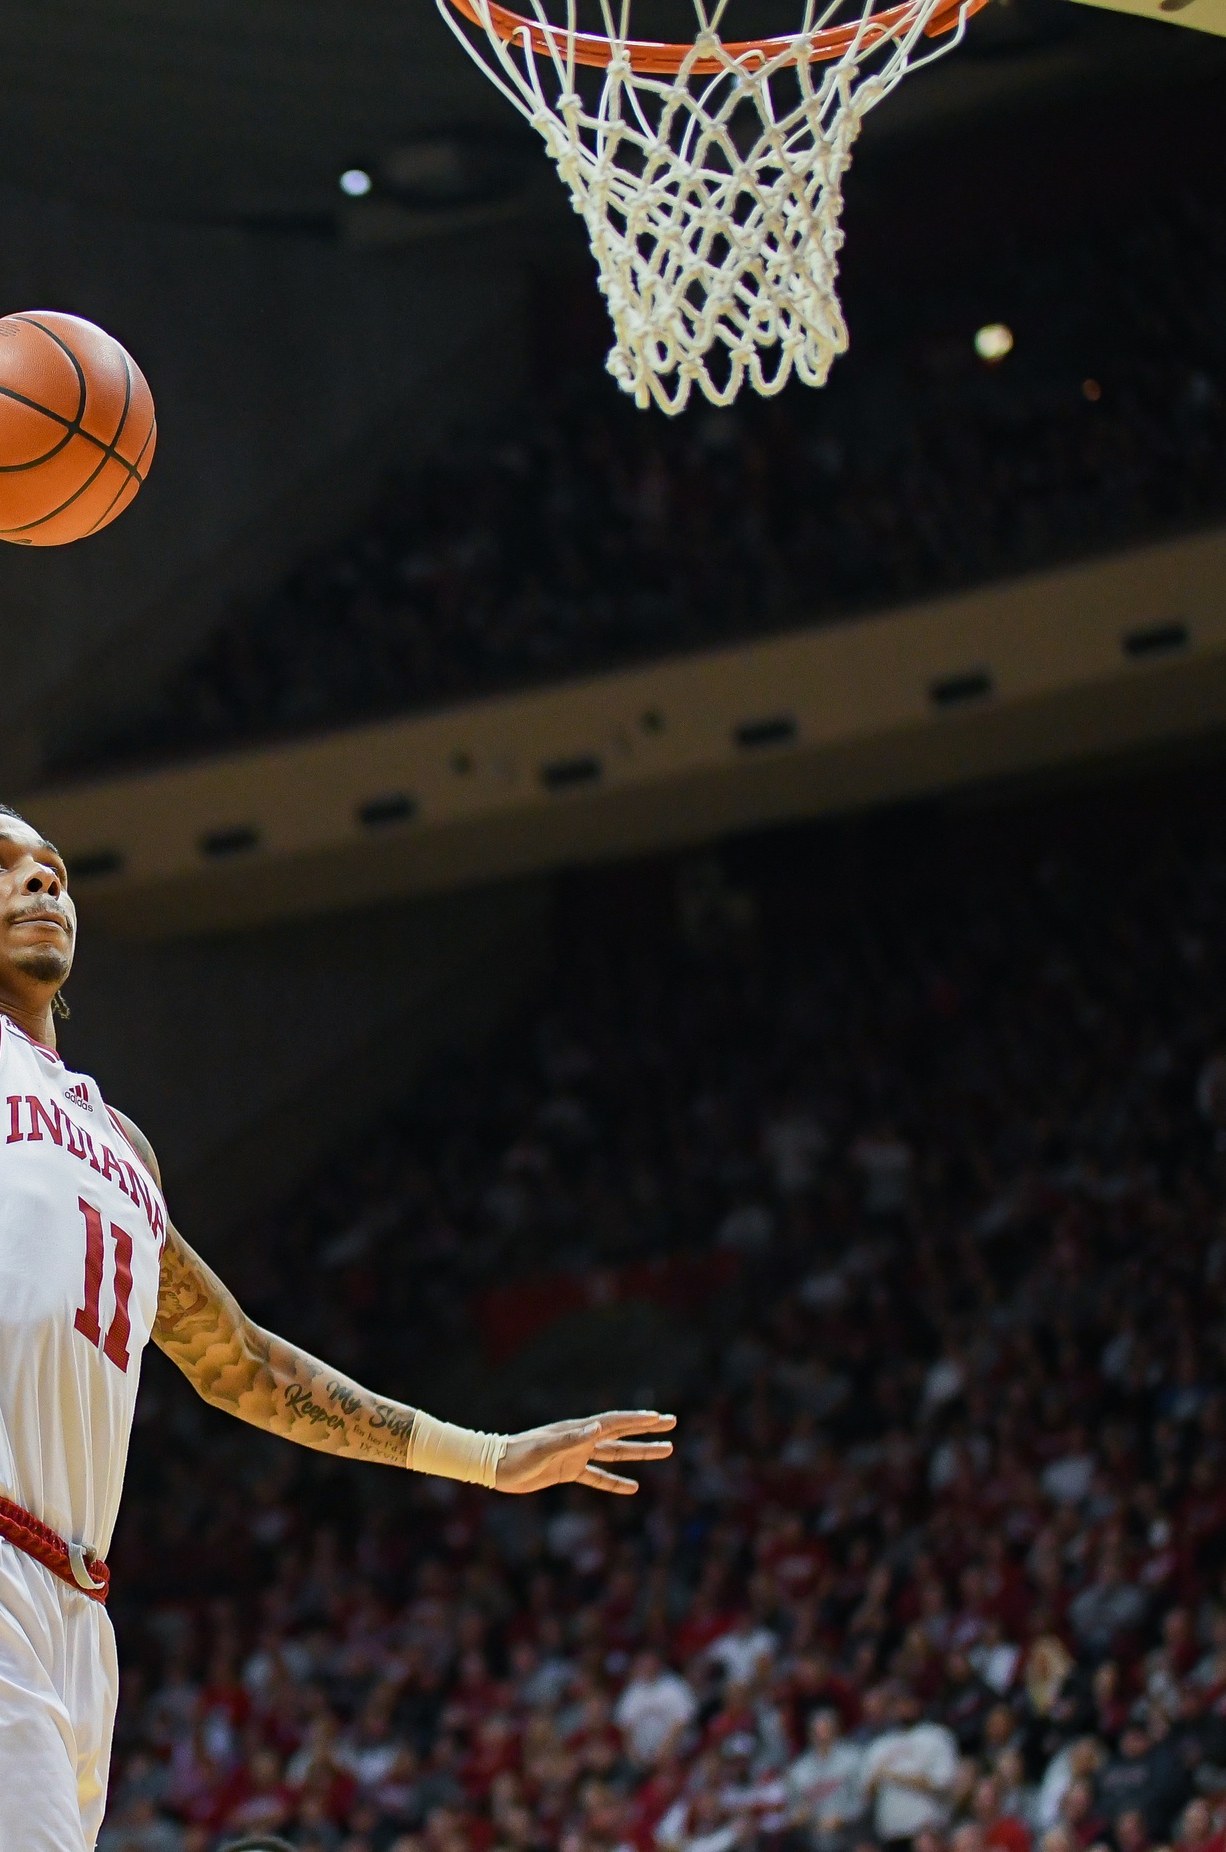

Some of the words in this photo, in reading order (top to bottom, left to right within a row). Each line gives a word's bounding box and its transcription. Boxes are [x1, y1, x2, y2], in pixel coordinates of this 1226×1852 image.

[64, 1091, 94, 1113] adidas
[6, 1095, 165, 1242] INDIANA
[74, 1195, 133, 1374] 11
[284, 1383, 345, 1430] Keeper
[326, 1381, 362, 1415] My
